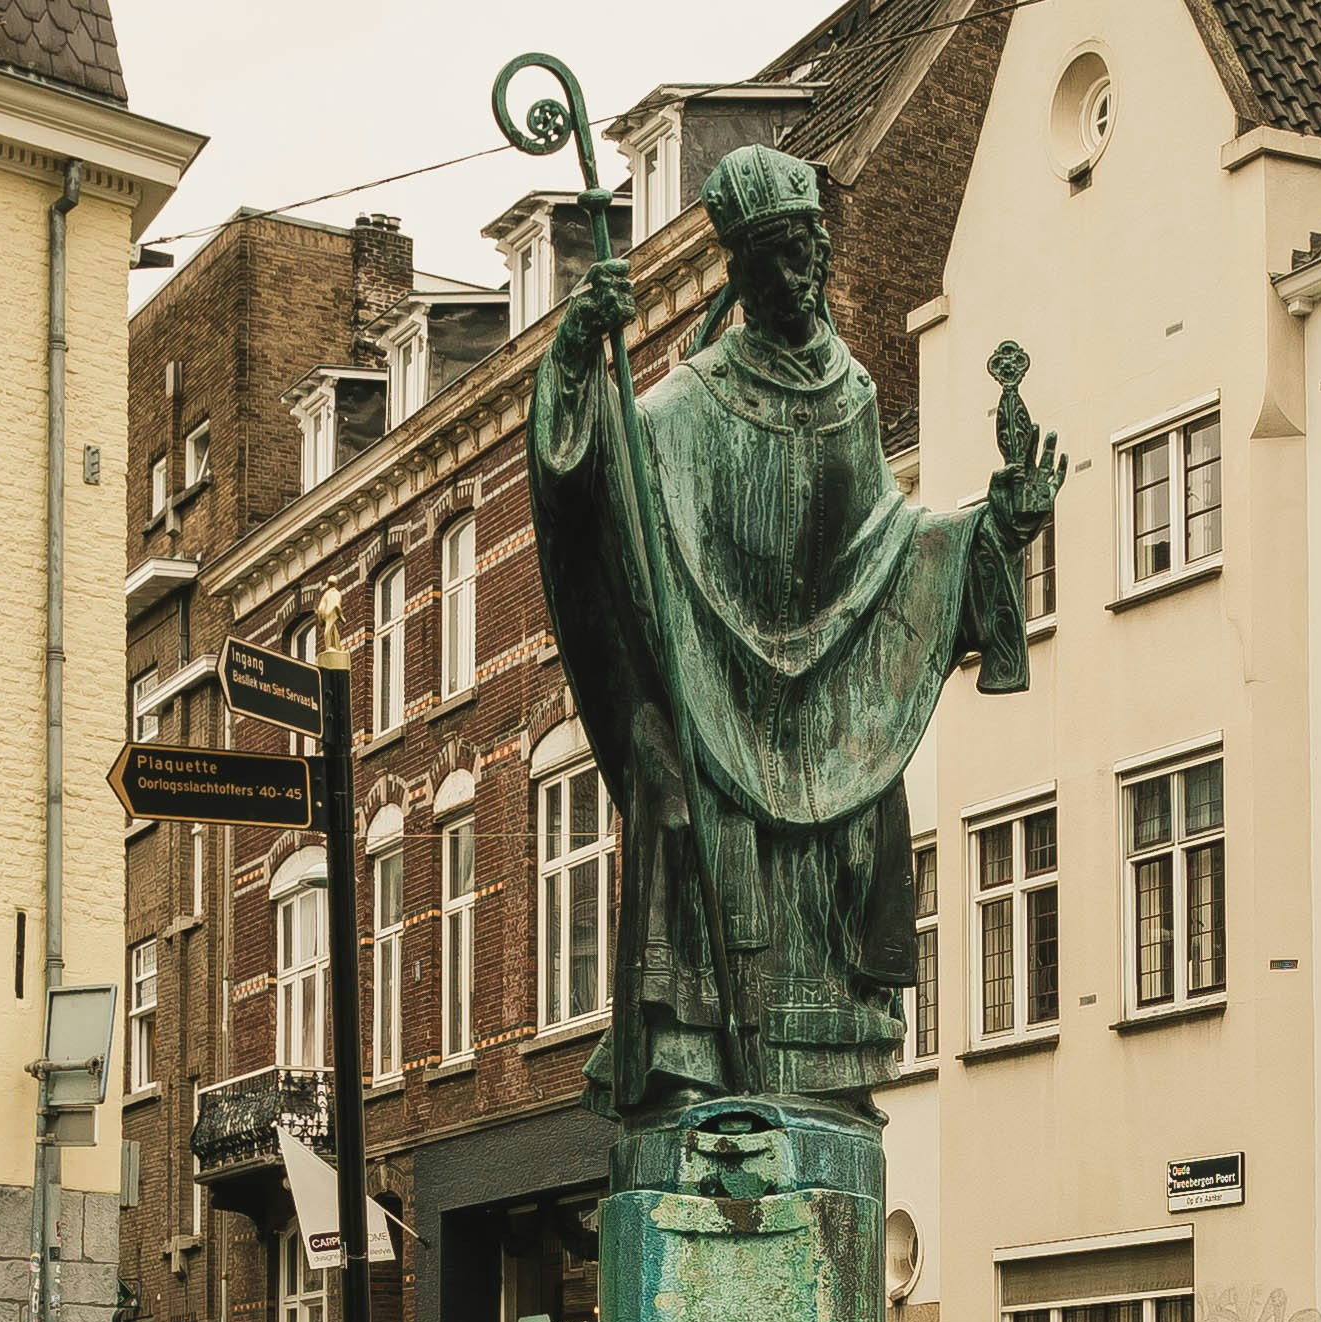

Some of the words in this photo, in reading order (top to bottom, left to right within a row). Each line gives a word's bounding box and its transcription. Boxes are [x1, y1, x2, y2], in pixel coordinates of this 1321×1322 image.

[231, 647, 264, 675] Ingang
[232, 669, 258, 689] Basiliek
[259, 680, 271, 694] van
[272, 683, 285, 698] Sint
[285, 688, 311, 707] Servaas
[137, 754, 218, 774] Plaquette
[137, 776, 254, 797] Oorlogsslachtoffers
[1172, 1165, 1191, 1177] Oude
[1215, 1173, 1236, 1184] Poort
[312, 1236, 340, 1249] CARP
[368, 1231, 388, 1242] OME
